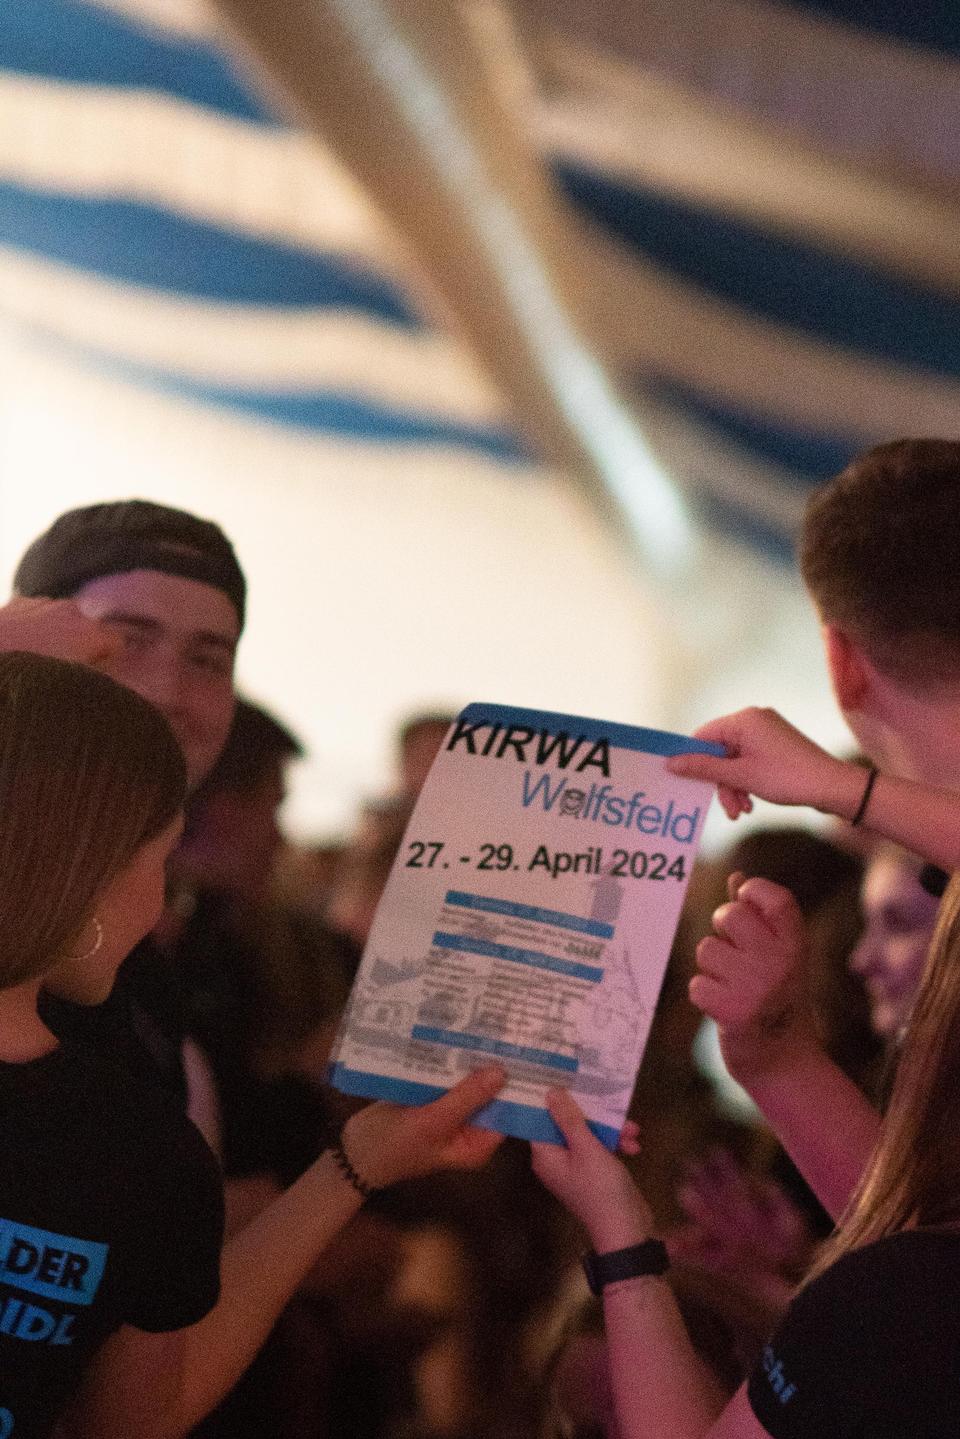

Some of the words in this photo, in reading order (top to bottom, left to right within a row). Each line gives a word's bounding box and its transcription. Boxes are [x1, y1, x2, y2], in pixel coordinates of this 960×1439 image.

[447, 718, 612, 777] KIRWA
[521, 769, 700, 844] Wolfsfeld
[405, 841, 449, 870] 27.
[476, 843, 519, 871] 29.
[528, 845, 601, 879] April
[610, 849, 686, 882] 2024
[0, 1237, 89, 1291] DER
